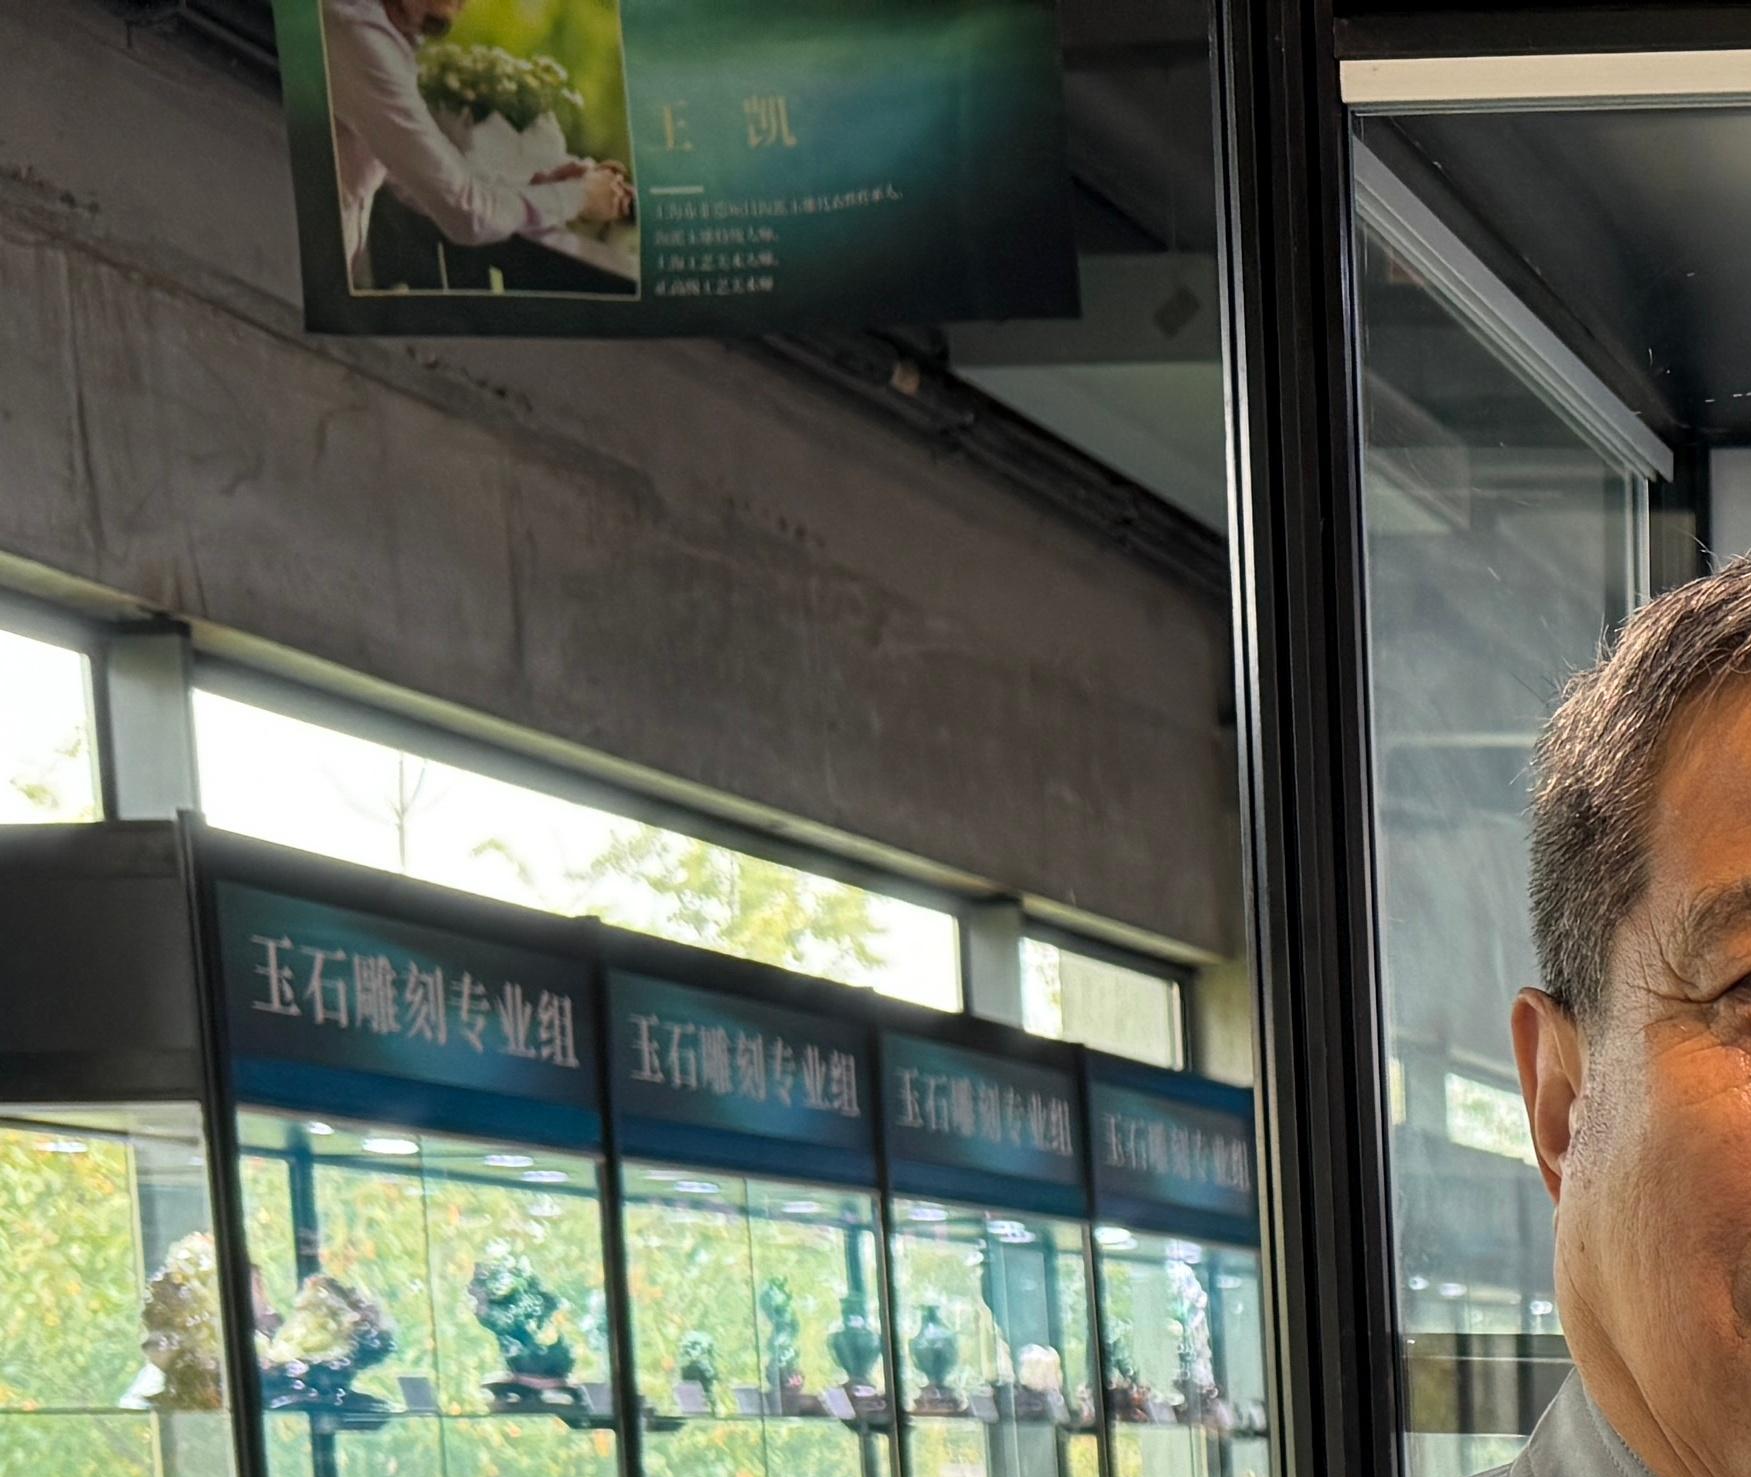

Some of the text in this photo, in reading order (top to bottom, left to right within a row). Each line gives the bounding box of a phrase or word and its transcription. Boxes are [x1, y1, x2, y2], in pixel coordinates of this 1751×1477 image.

[251, 934, 581, 1069] 玉石雕刻专业组
[628, 1013, 861, 1118] 玉石雕刻专业组
[895, 1067, 1074, 1157] 玉石雕刻专业组
[1102, 1112, 1250, 1192] 玉石雕刻专业组
